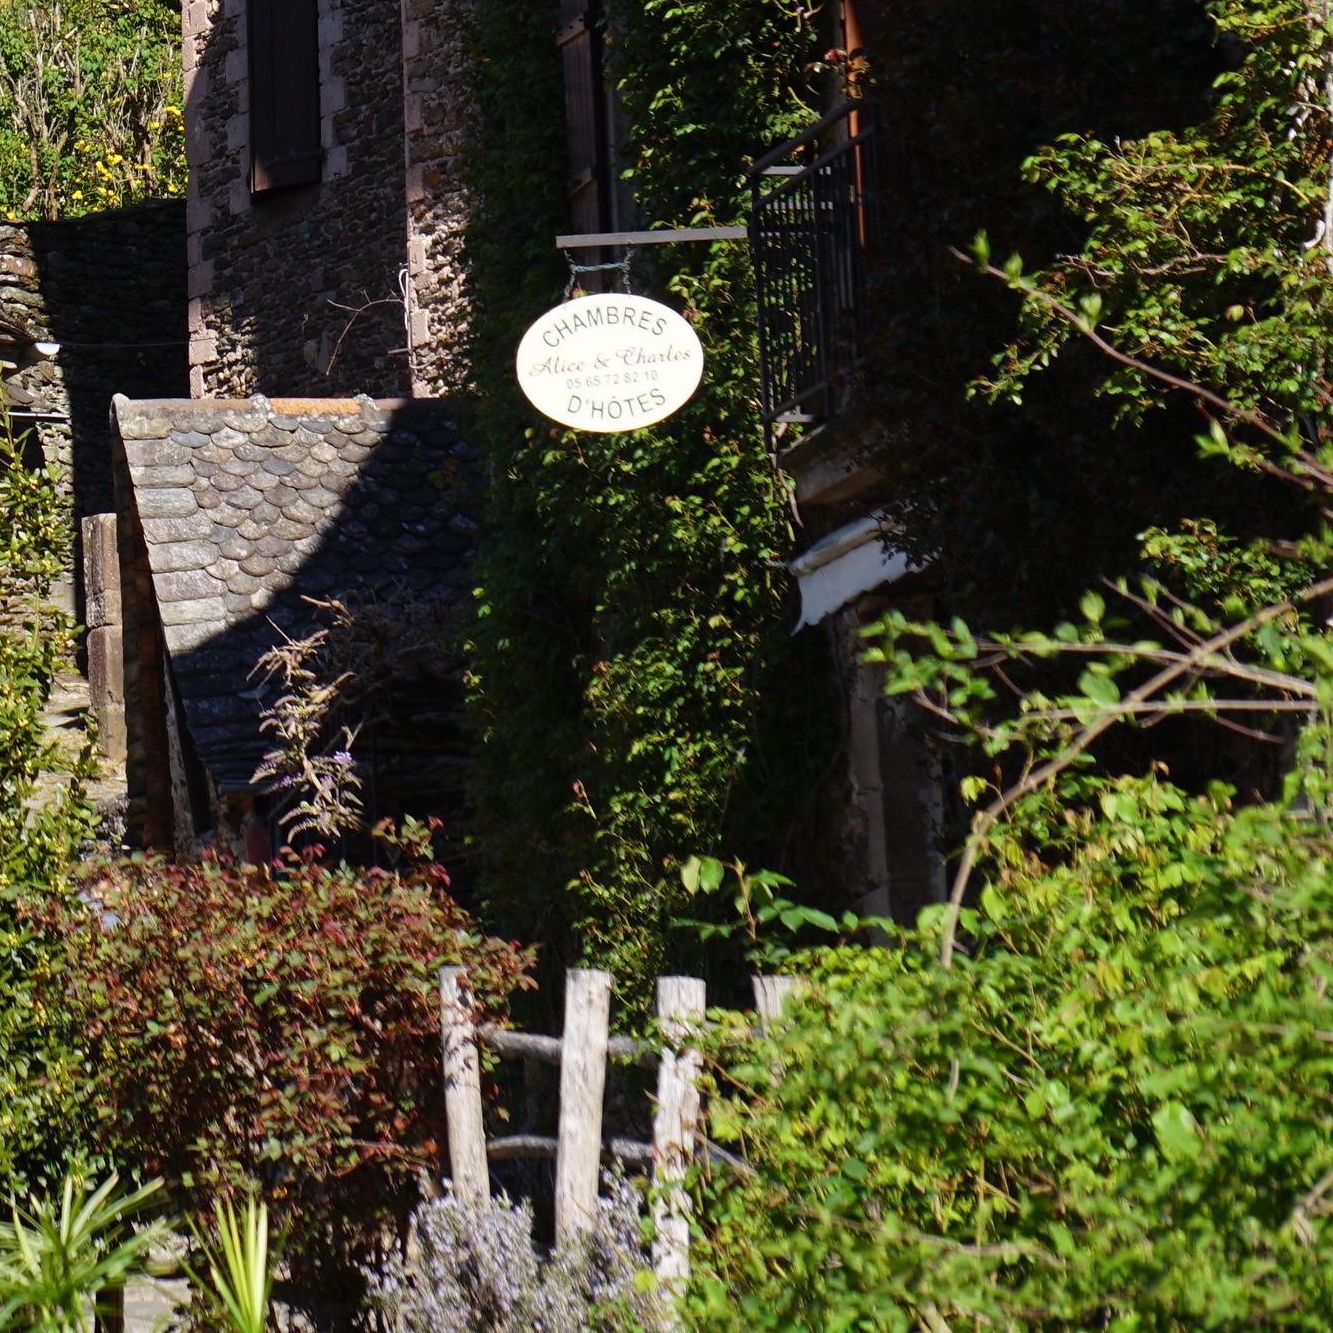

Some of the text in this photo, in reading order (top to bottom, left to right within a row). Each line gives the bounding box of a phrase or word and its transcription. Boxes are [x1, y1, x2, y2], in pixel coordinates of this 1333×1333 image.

[542, 306, 667, 347] CHAMBRES
[529, 344, 692, 377] Alice & Charles
[566, 369, 658, 390] 05 65 72 82 10
[567, 388, 666, 420] D'HÔTES
